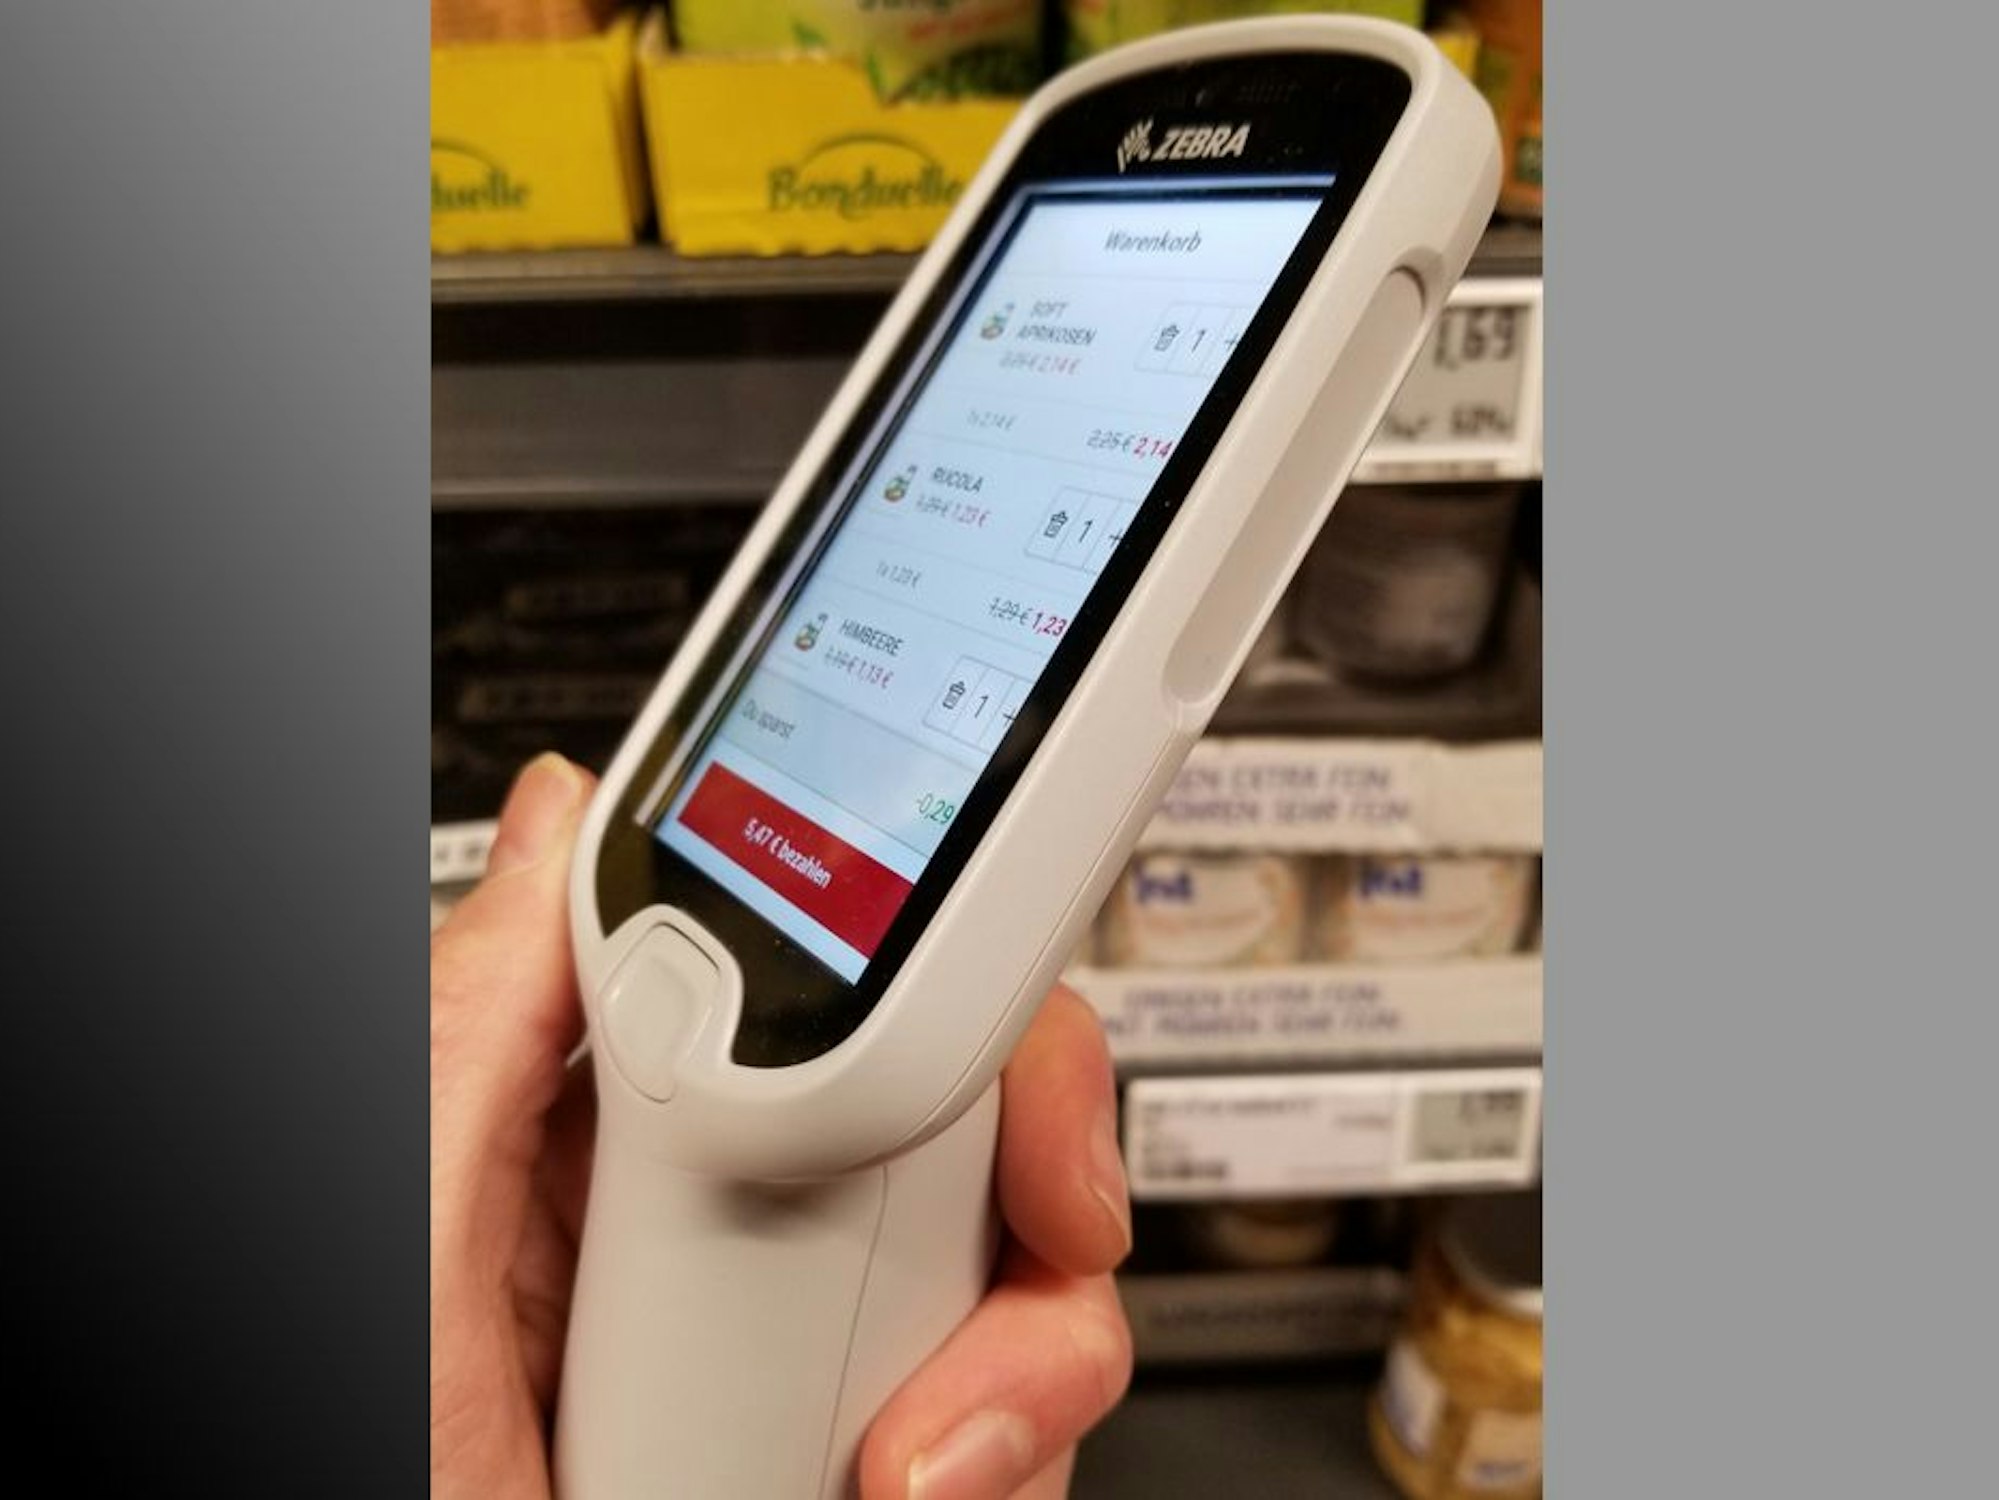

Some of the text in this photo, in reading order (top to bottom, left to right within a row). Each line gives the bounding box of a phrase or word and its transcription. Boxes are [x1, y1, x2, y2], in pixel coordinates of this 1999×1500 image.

[1151, 123, 1251, 161] ZEBRA
[1105, 230, 1202, 253] Warenkorb
[1017, 324, 1098, 346] APRIKOSEN
[1191, 329, 1206, 352] 1
[1132, 436, 1176, 459] 2,14
[933, 466, 984, 494] RUCOLA
[1079, 520, 1093, 543] 1
[1031, 611, 1068, 638] 1,23
[839, 618, 904, 658] HIMBEERE
[973, 694, 989, 719] 1
[744, 817, 775, 847] 5,47
[777, 839, 832, 889] bezahlen
